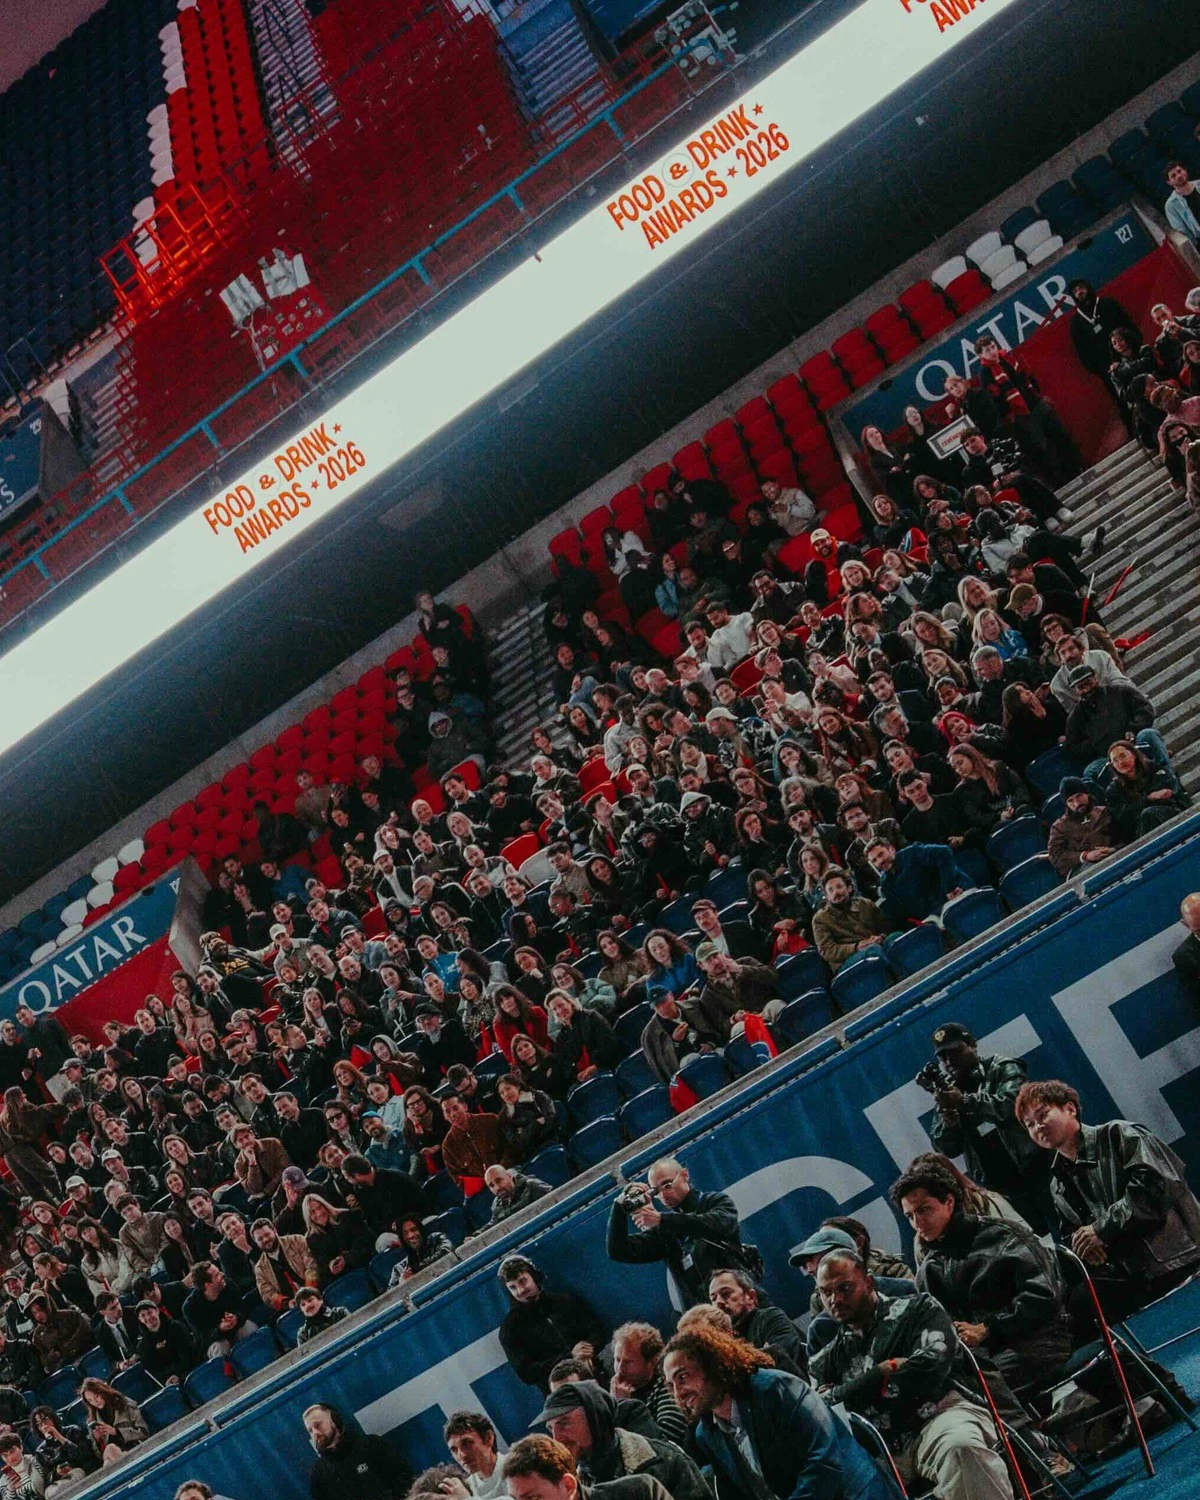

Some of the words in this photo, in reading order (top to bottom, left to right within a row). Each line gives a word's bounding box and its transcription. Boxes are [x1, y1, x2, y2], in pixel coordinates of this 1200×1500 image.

[606, 174, 666, 231] FOOD
[669, 161, 689, 181] &
[686, 103, 758, 171] DRINK
[640, 169, 729, 250] AWARDS
[734, 122, 790, 178] 2026
[915, 274, 1076, 401] QATAR
[203, 484, 256, 534] FOOD
[259, 474, 276, 491] &
[273, 422, 337, 482] DRINK
[233, 481, 313, 553] AWARDS
[316, 441, 366, 490] 2026
[18, 916, 147, 1016] QATAR
